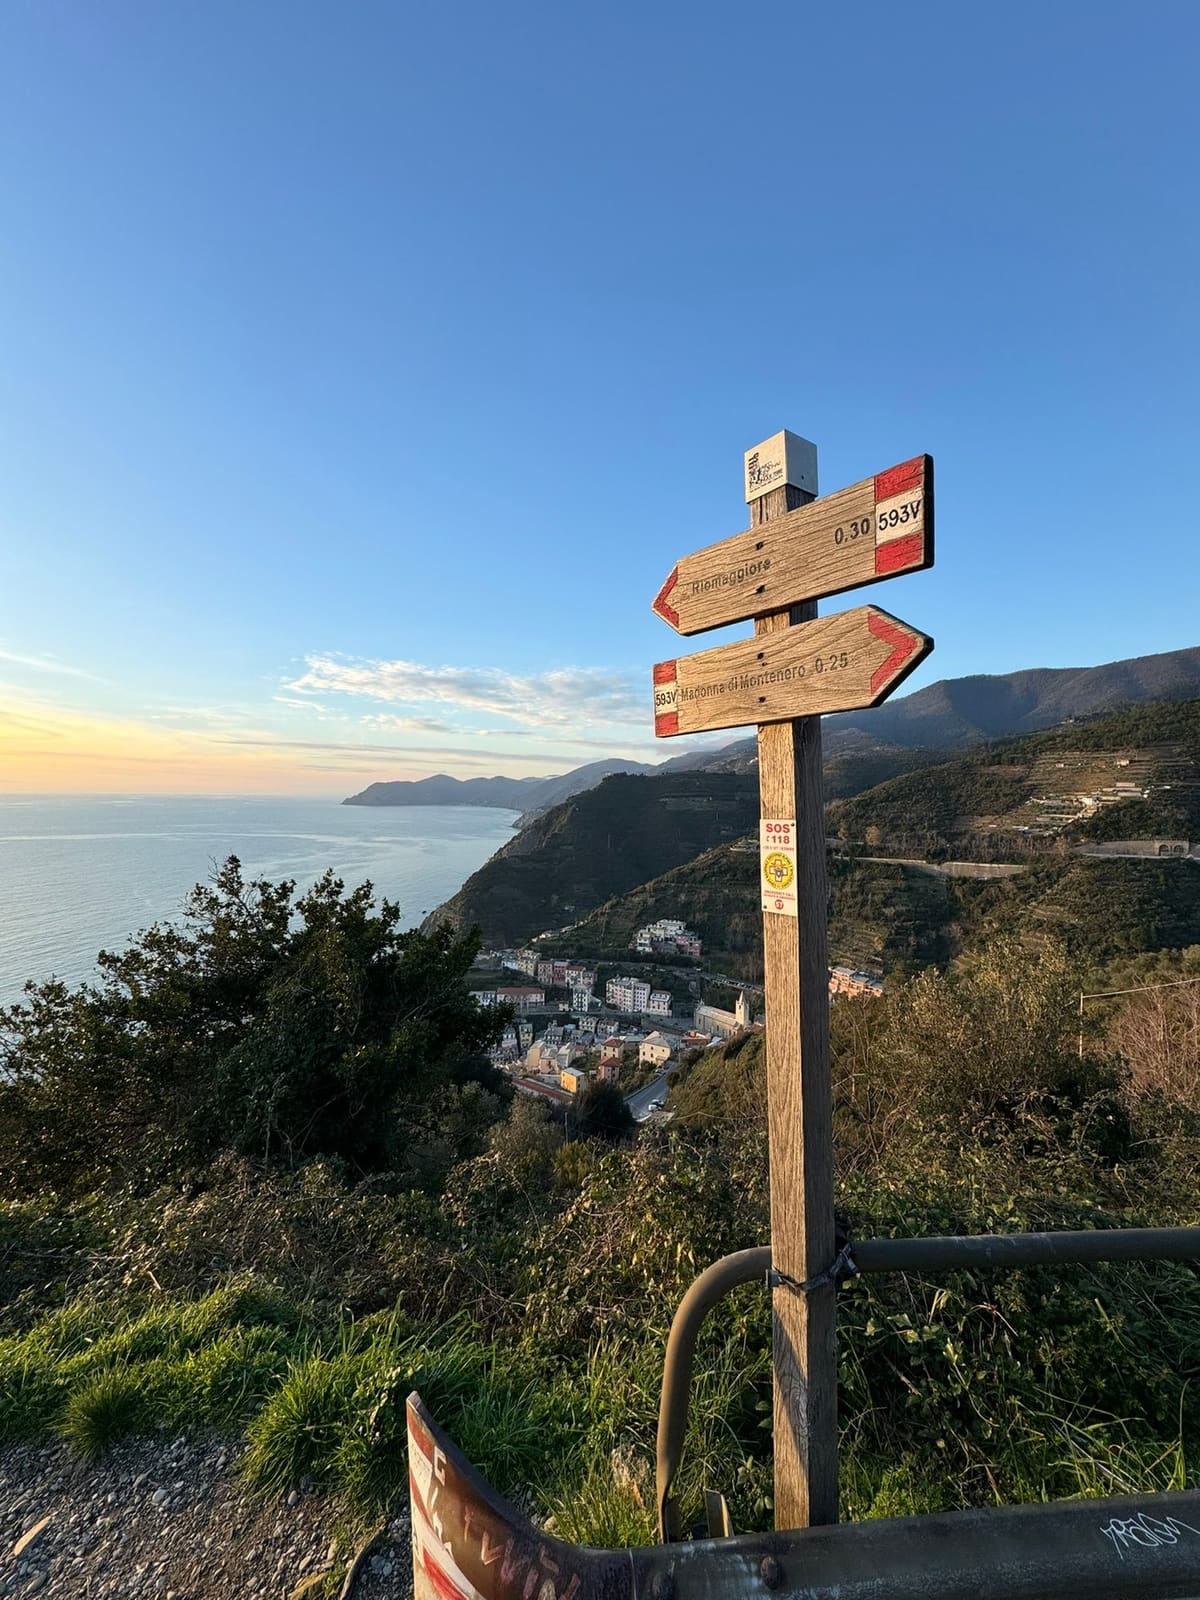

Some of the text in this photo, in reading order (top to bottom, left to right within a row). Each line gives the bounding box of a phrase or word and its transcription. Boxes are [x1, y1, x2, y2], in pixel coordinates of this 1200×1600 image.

[691, 500, 921, 596] Riomaggiore 0.30 593V
[655, 651, 849, 707] 593V Madonna di Montenero 0.25
[766, 823, 790, 834] SOS
[771, 835, 790, 845] 118
